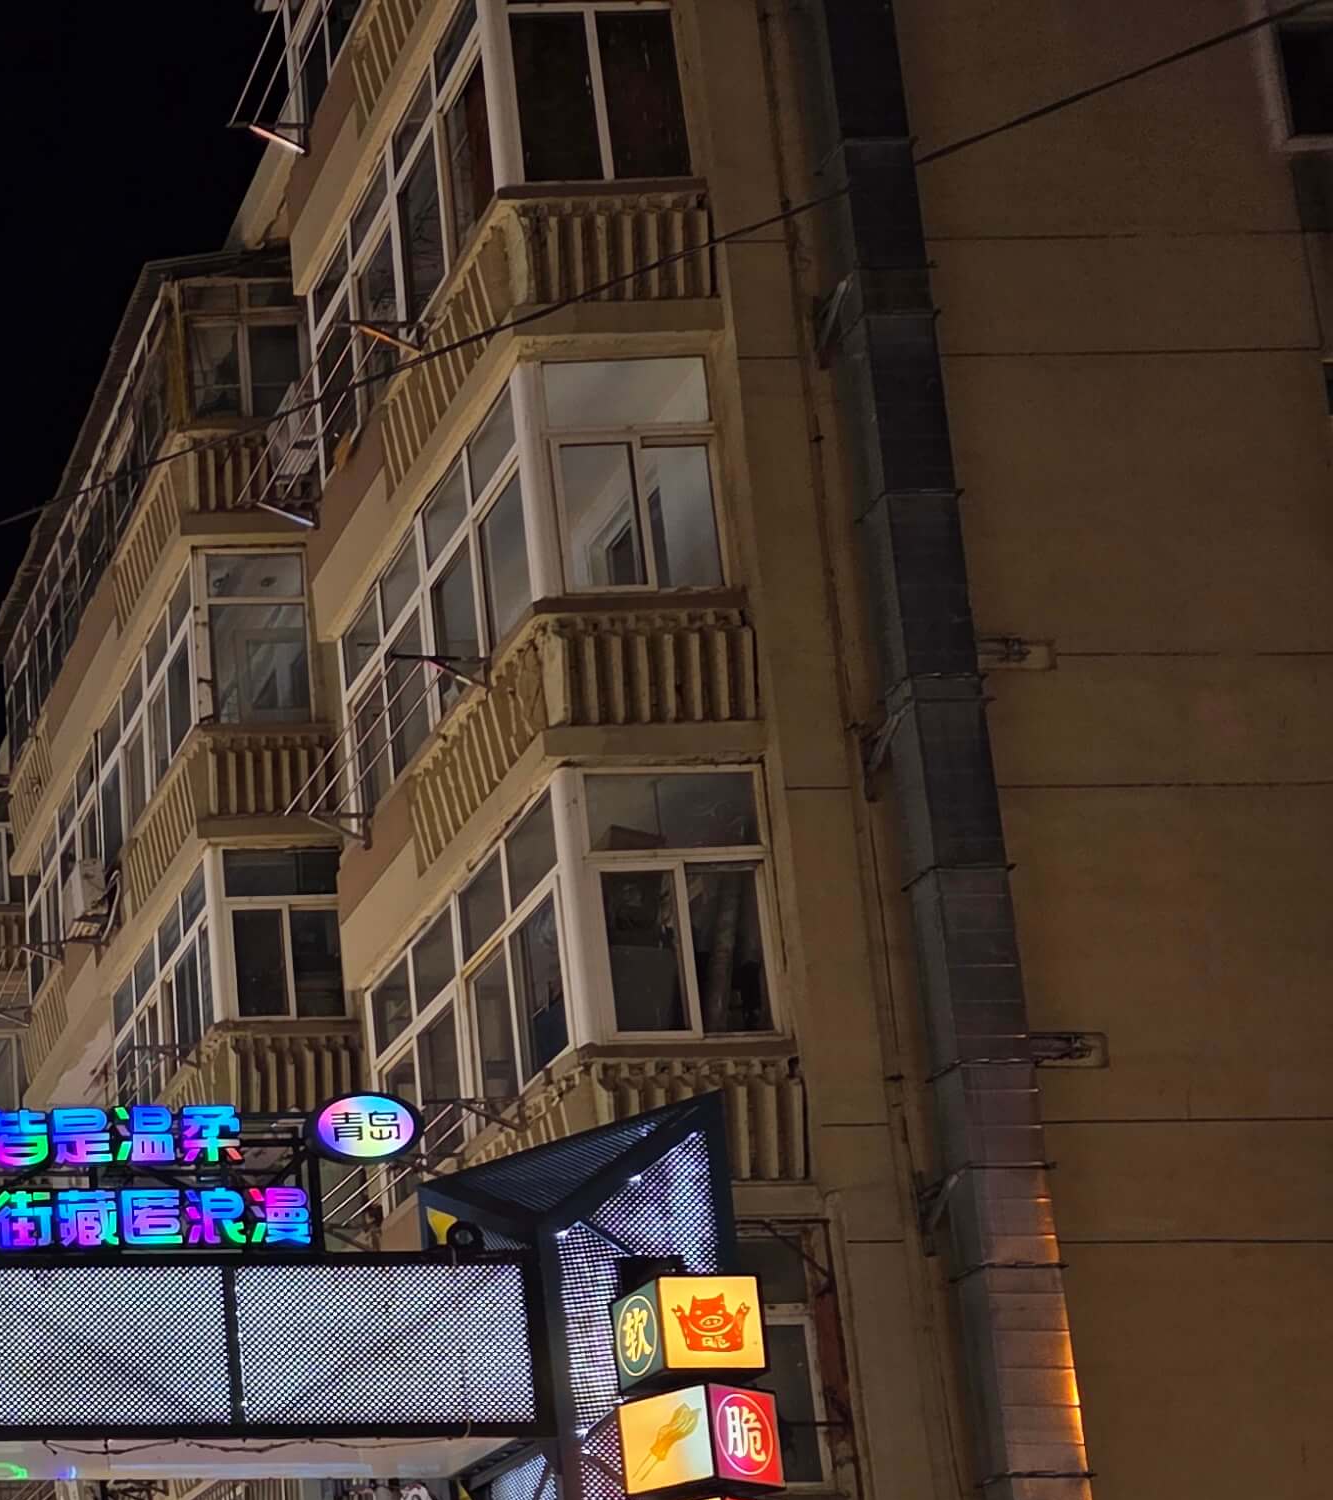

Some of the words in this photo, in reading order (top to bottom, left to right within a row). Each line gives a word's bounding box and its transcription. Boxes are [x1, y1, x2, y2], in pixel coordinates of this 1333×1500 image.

[329, 1109, 402, 1144] 青岛
[622, 1300, 653, 1363] 软
[726, 1405, 766, 1464] 脆
